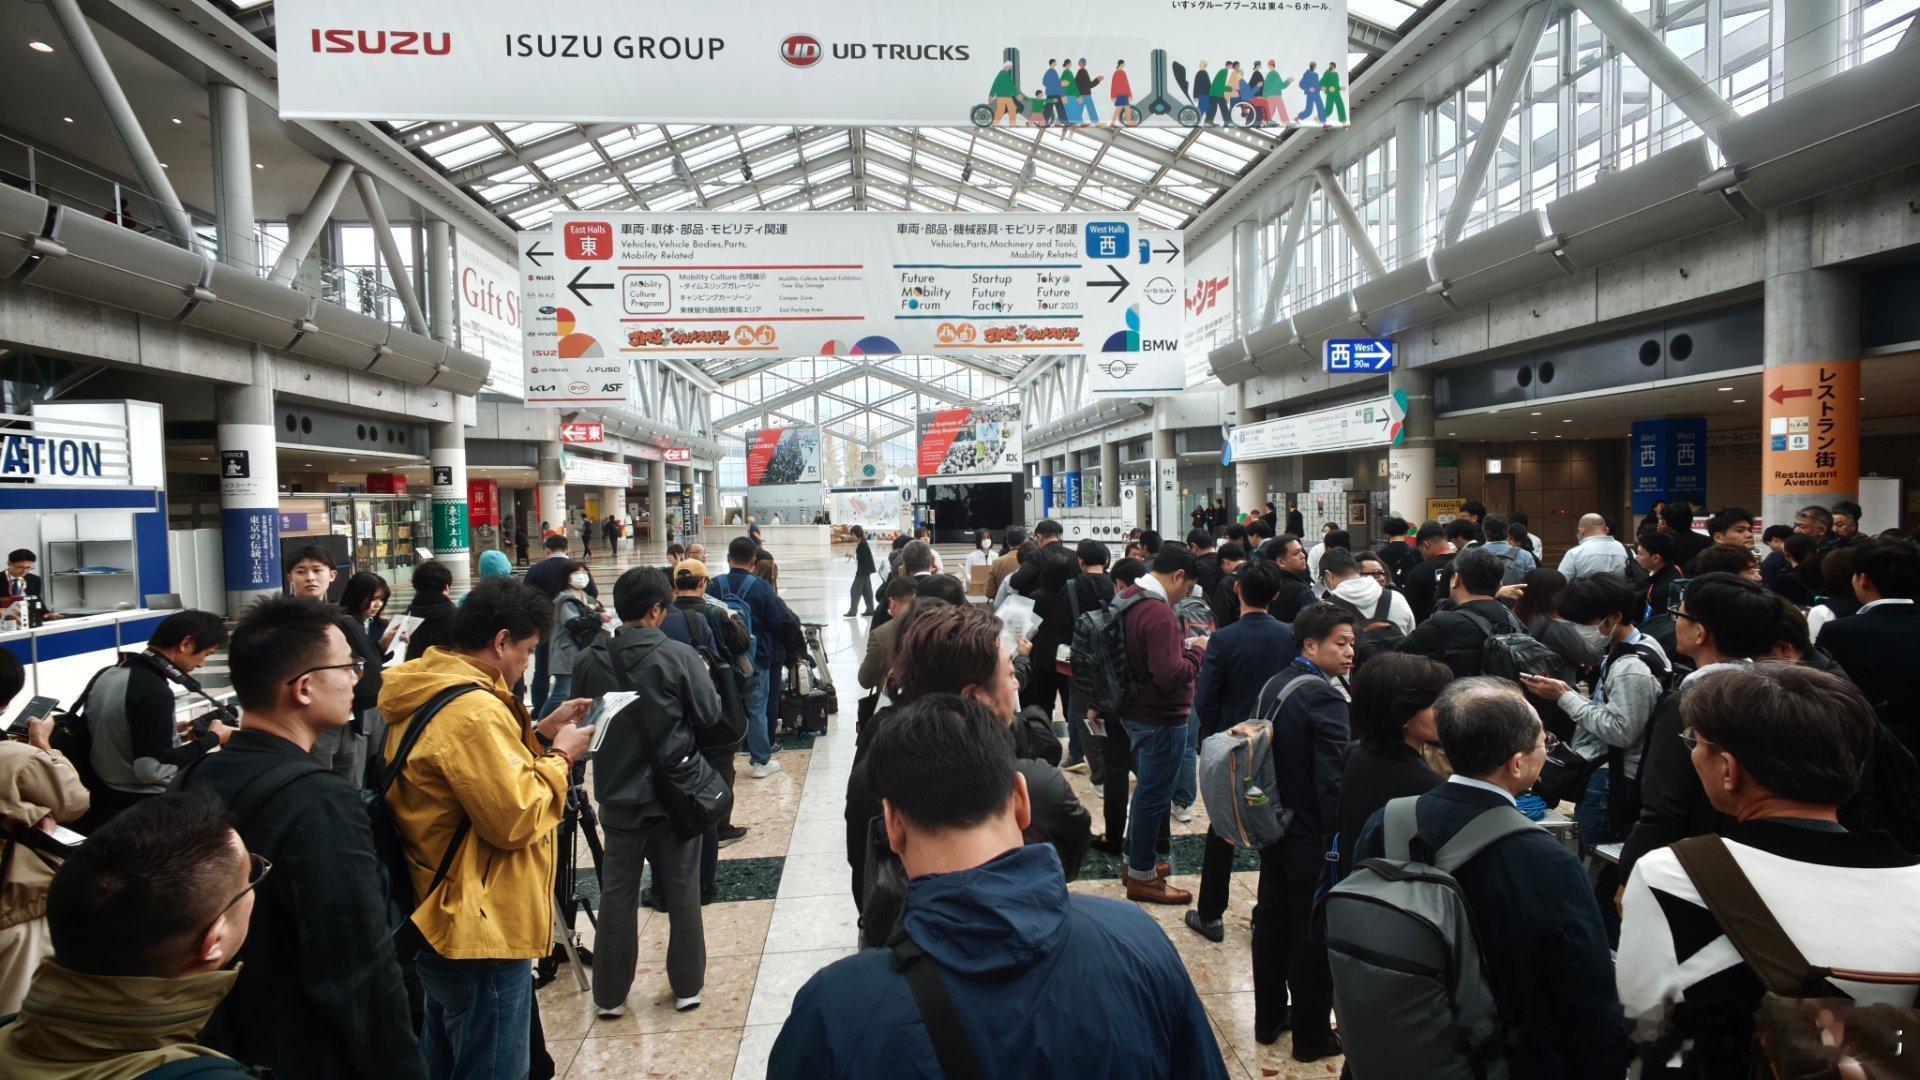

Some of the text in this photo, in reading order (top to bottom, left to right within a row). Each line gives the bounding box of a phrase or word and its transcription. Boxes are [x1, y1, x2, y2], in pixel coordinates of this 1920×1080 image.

[311, 29, 451, 56] ISUZU
[505, 34, 725, 60] ISUZU GROUP
[832, 43, 969, 61] UD TRUCKS
[571, 226, 606, 235] East Halls
[1090, 225, 1125, 234] West Halls
[580, 236, 598, 257] 東
[1036, 240, 1052, 248] and
[1099, 235, 1116, 255] 西
[621, 251, 694, 261] Mobility Related
[1011, 251, 1078, 261] Mobility Related
[902, 273, 934, 283] Future
[972, 274, 1012, 286] Startup
[1037, 273, 1070, 285] Tokyo
[629, 281, 663, 289] Mobility
[463, 267, 502, 320] Gift
[629, 290, 656, 298] Culture
[902, 286, 951, 299] Mobility
[972, 288, 1005, 297] Future
[1037, 288, 1070, 297] Future
[631, 299, 665, 308] Program
[902, 299, 940, 310] Forum
[972, 300, 1013, 312] Factory
[1037, 300, 1059, 310] Tour
[1142, 339, 1179, 352] BMW
[1354, 343, 1374, 352] West
[1331, 344, 1350, 368] 西
[1354, 359, 1370, 368] 90m
[601, 383, 624, 393] ASF
[1816, 368, 1836, 469] レストラン街
[588, 425, 601, 440] 東
[2, 436, 102, 476] ATION
[1640, 444, 1656, 467] 西
[1775, 470, 1838, 479] Restaurant
[1784, 479, 1829, 487] Avenue
[683, 498, 692, 533] PRONTO
